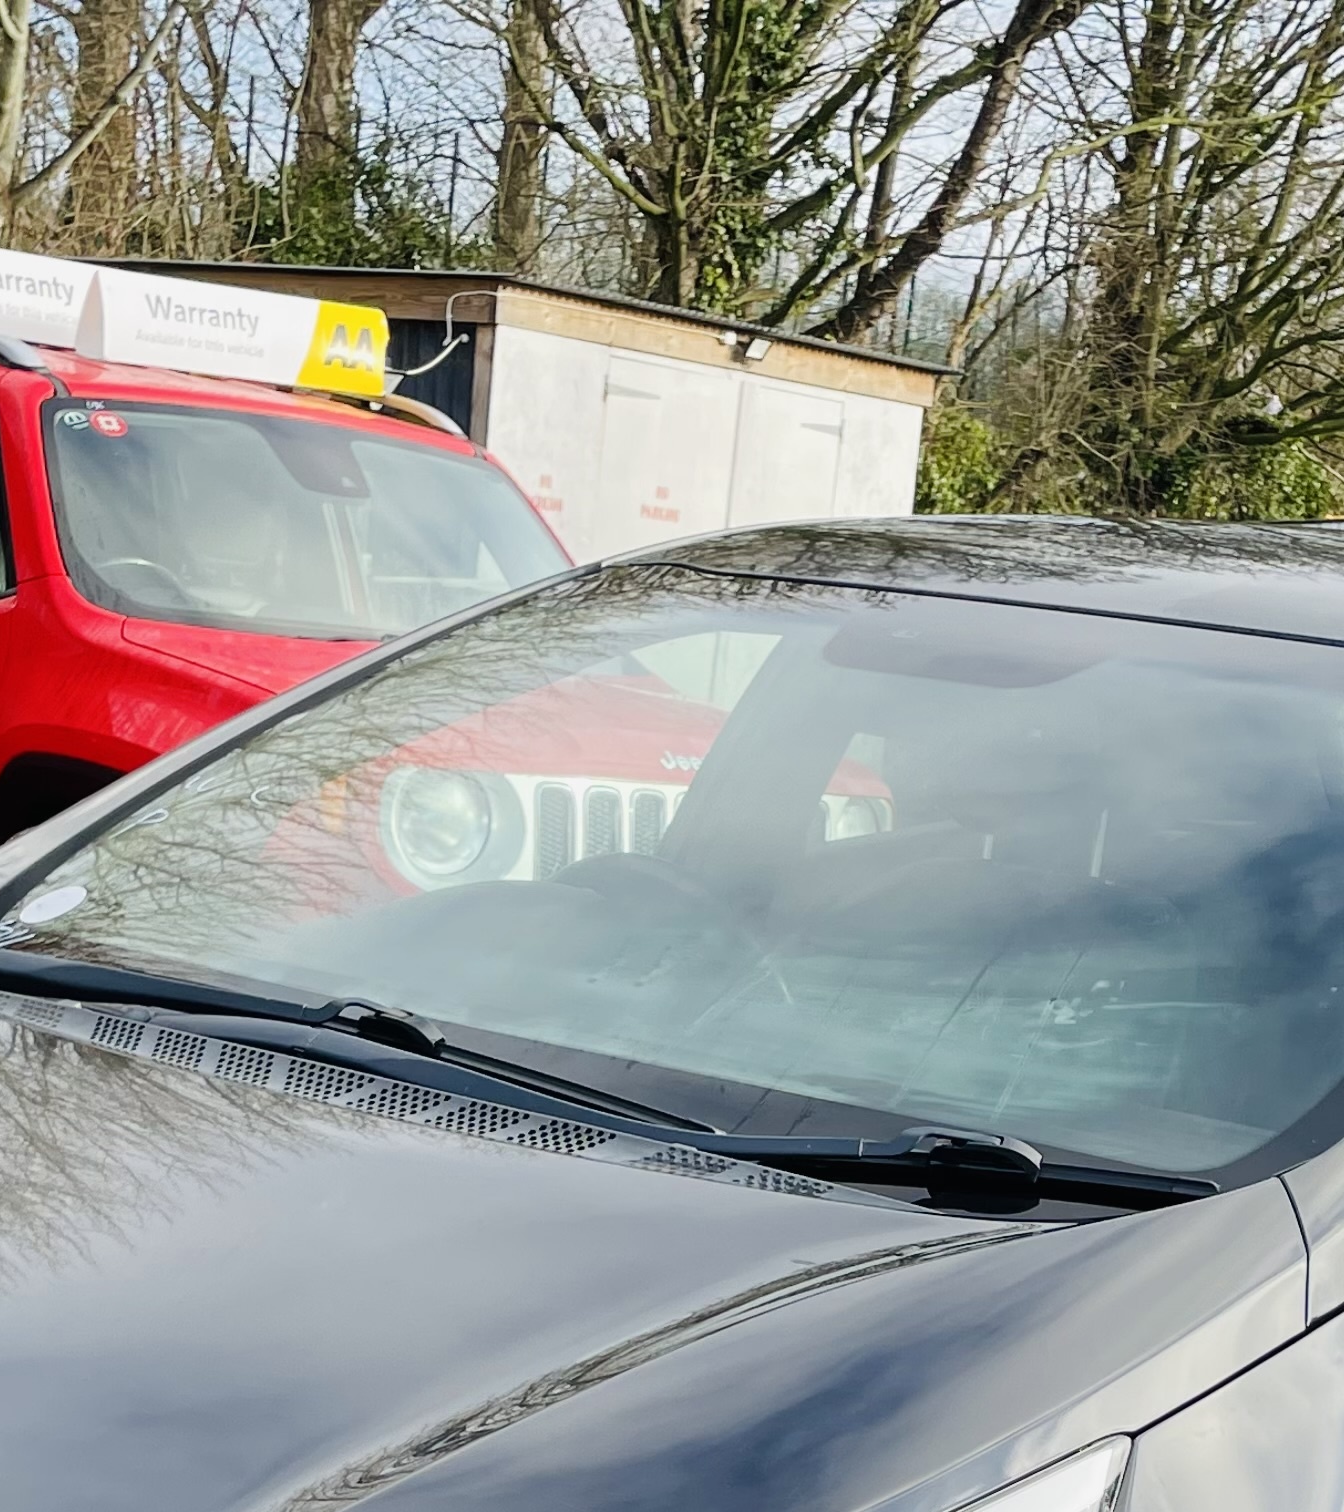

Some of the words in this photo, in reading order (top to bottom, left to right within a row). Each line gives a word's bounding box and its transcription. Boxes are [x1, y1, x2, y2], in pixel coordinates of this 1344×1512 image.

[145, 293, 260, 339] Warranty
[323, 324, 374, 372] AA
[660, 750, 704, 772] Jee
